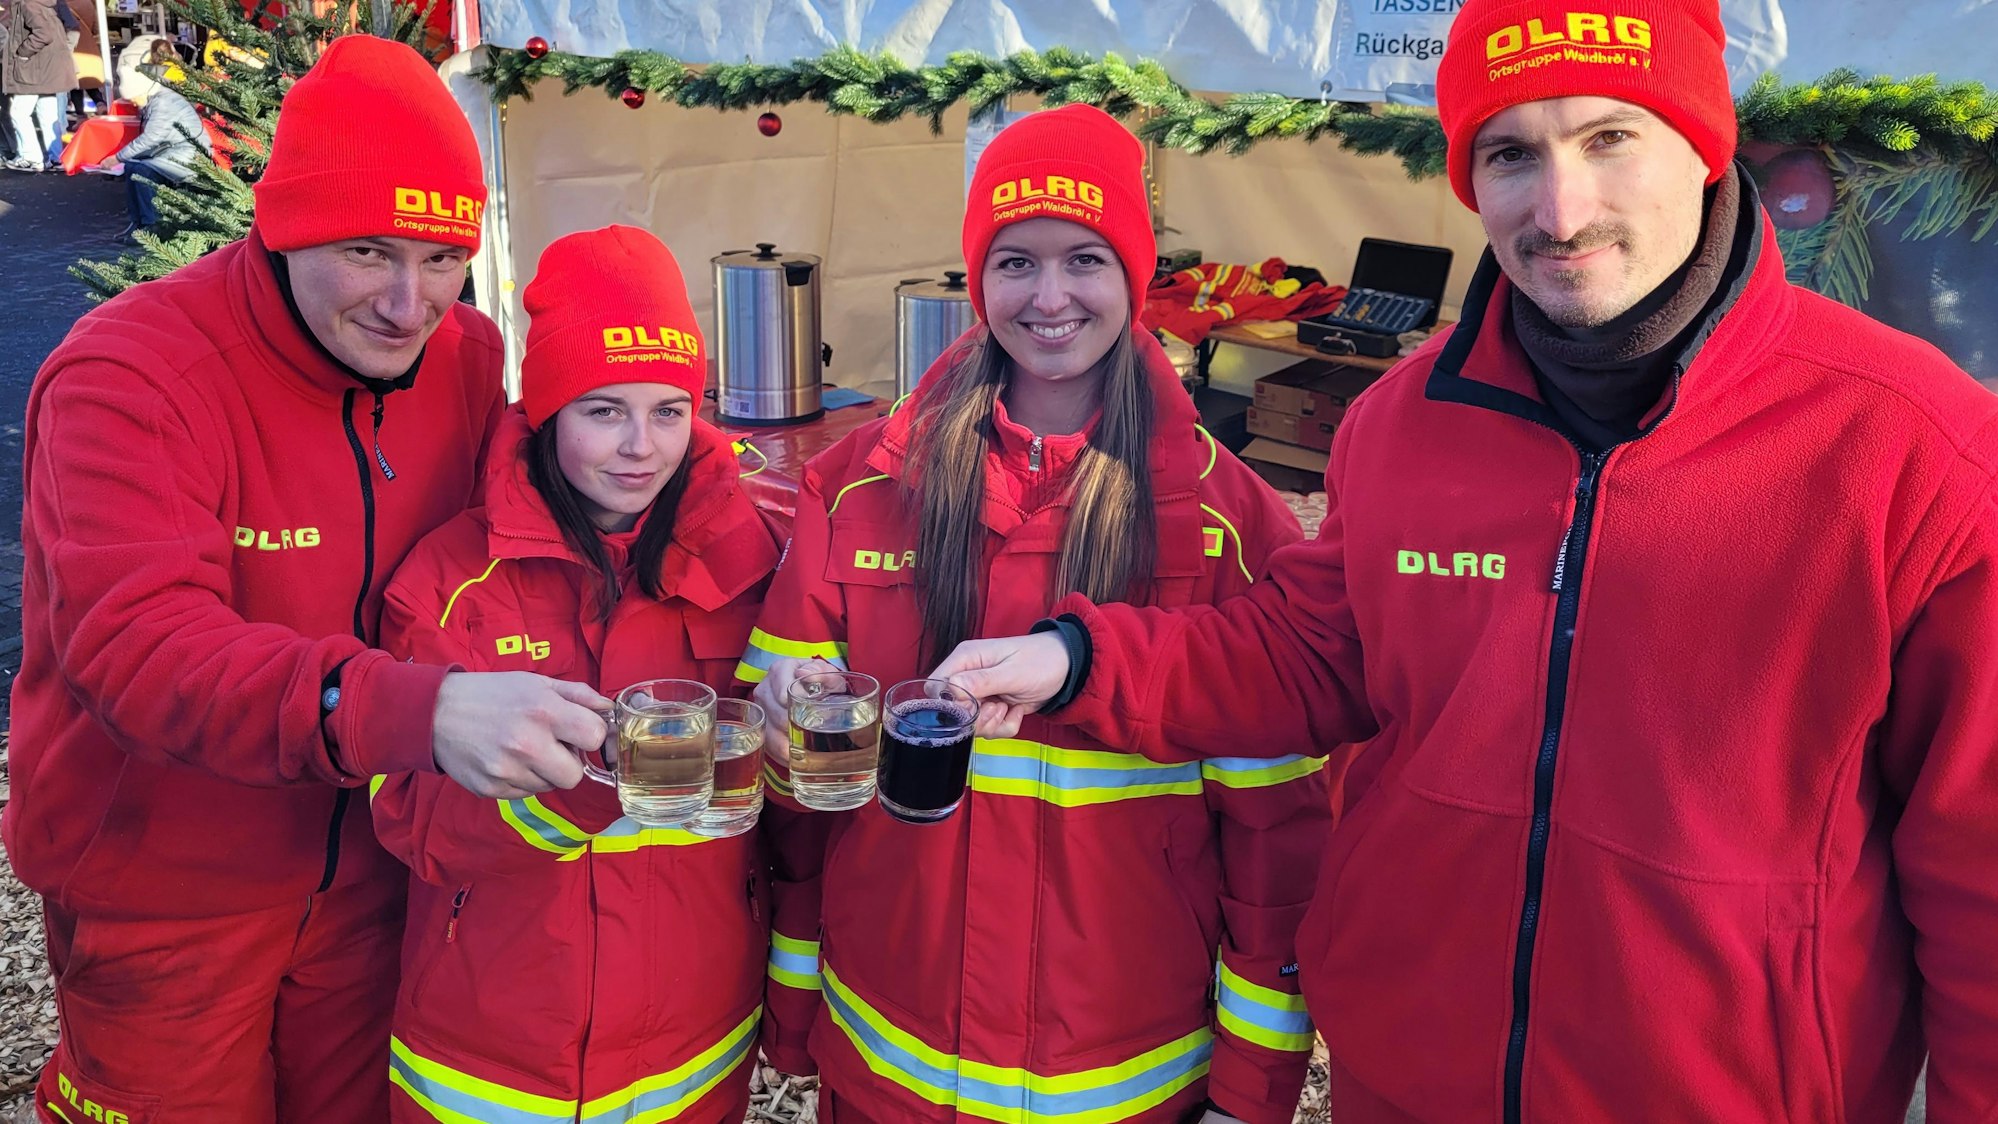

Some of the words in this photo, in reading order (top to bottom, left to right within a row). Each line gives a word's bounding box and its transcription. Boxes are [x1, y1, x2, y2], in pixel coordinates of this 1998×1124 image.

[1356, 32, 1449, 60] Rückga
[1486, 12, 1652, 60] DLRG
[1488, 51, 1563, 82] Ortsgruppe
[992, 175, 1104, 207] DLRG
[394, 218, 450, 234] Ortsgruppe
[993, 202, 1042, 223] Ortsgruppe
[1042, 200, 1085, 218] Waldbröl
[602, 326, 699, 357] DLRG
[606, 351, 660, 364] Ortsgruppe
[233, 525, 321, 551] DLRG
[853, 549, 917, 572] DLR
[1397, 549, 1506, 580] DLRG
[58, 1072, 129, 1124] DLRG
